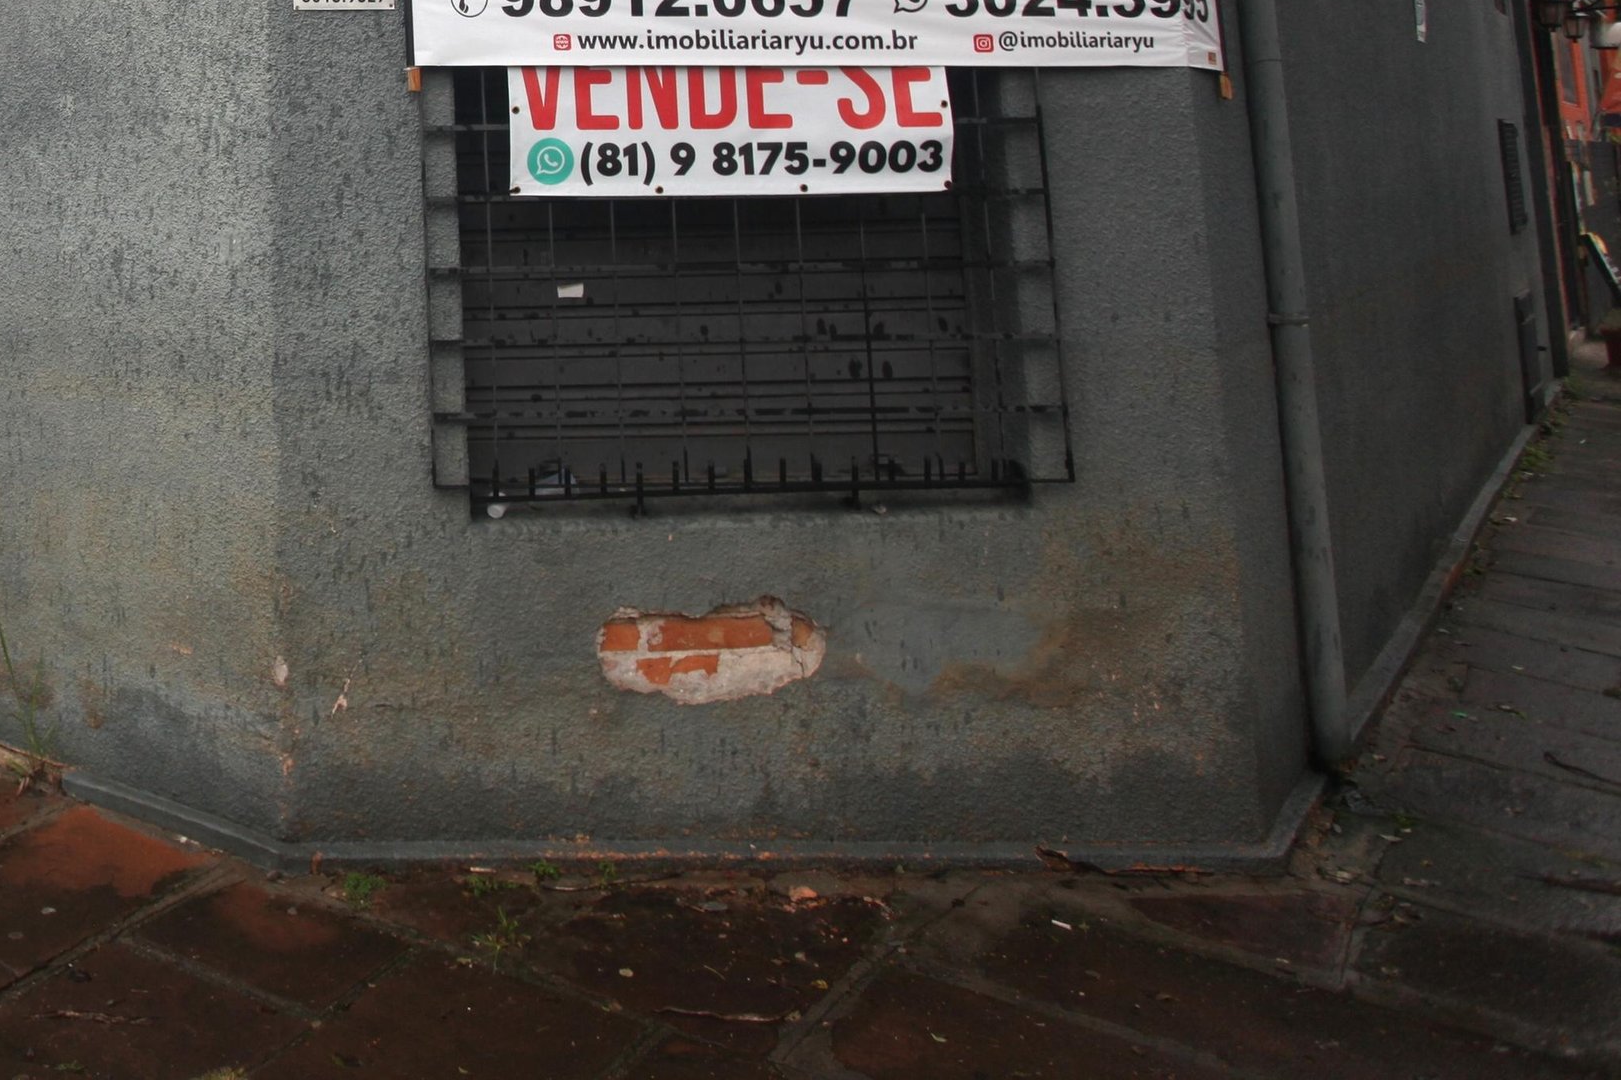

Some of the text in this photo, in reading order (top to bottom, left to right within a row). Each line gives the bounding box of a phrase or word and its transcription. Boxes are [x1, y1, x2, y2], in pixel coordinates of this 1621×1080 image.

[577, 30, 918, 56] www.imobiliariaryu.com.br
[998, 31, 1155, 53] @imobiliariaryu
[521, 66, 944, 131] VENDE-SE
[580, 139, 943, 186] (81) 9 8175-9003
